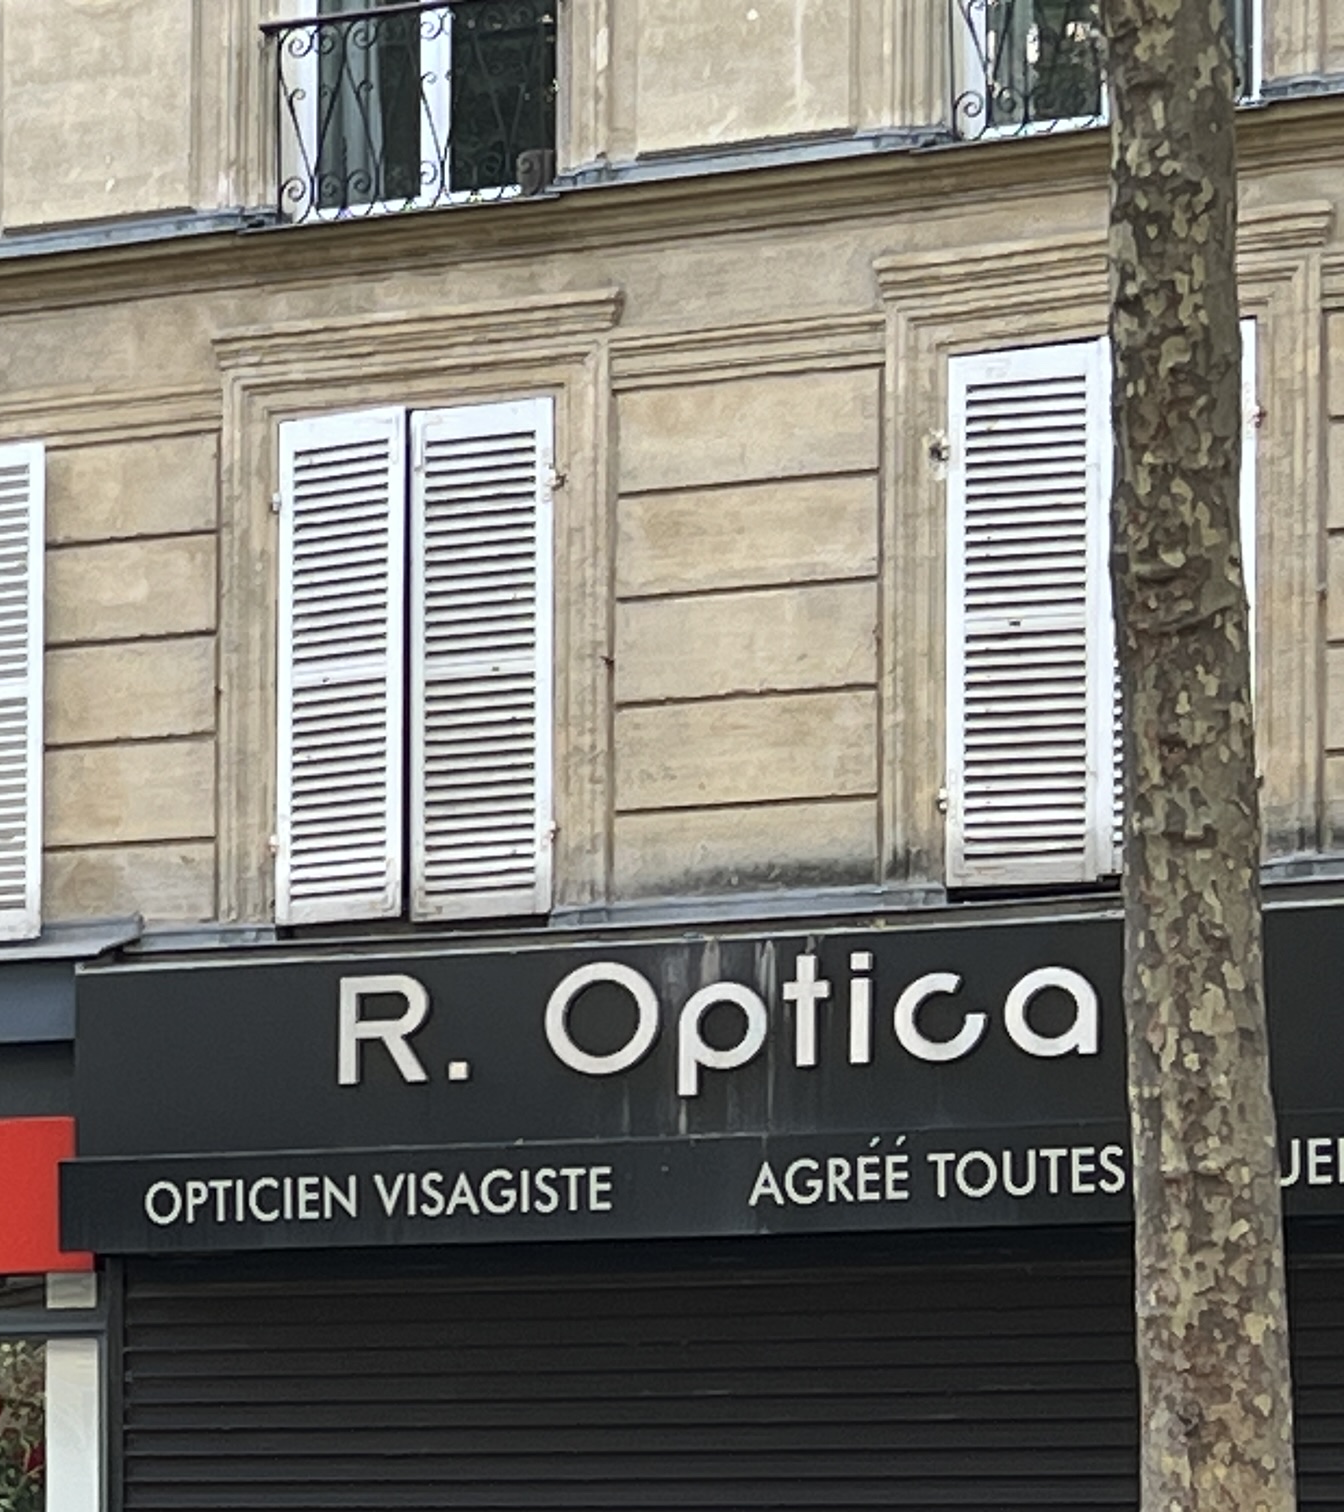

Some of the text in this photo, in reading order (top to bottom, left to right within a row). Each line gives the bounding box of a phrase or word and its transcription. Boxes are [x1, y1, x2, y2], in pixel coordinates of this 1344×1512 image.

[337, 951, 1100, 1097] R. Optica
[144, 1165, 614, 1226] OPTICIEN VISAGISTE
[748, 1135, 910, 1207] AGRÉÉ
[926, 1143, 1125, 1201] TOUTES
